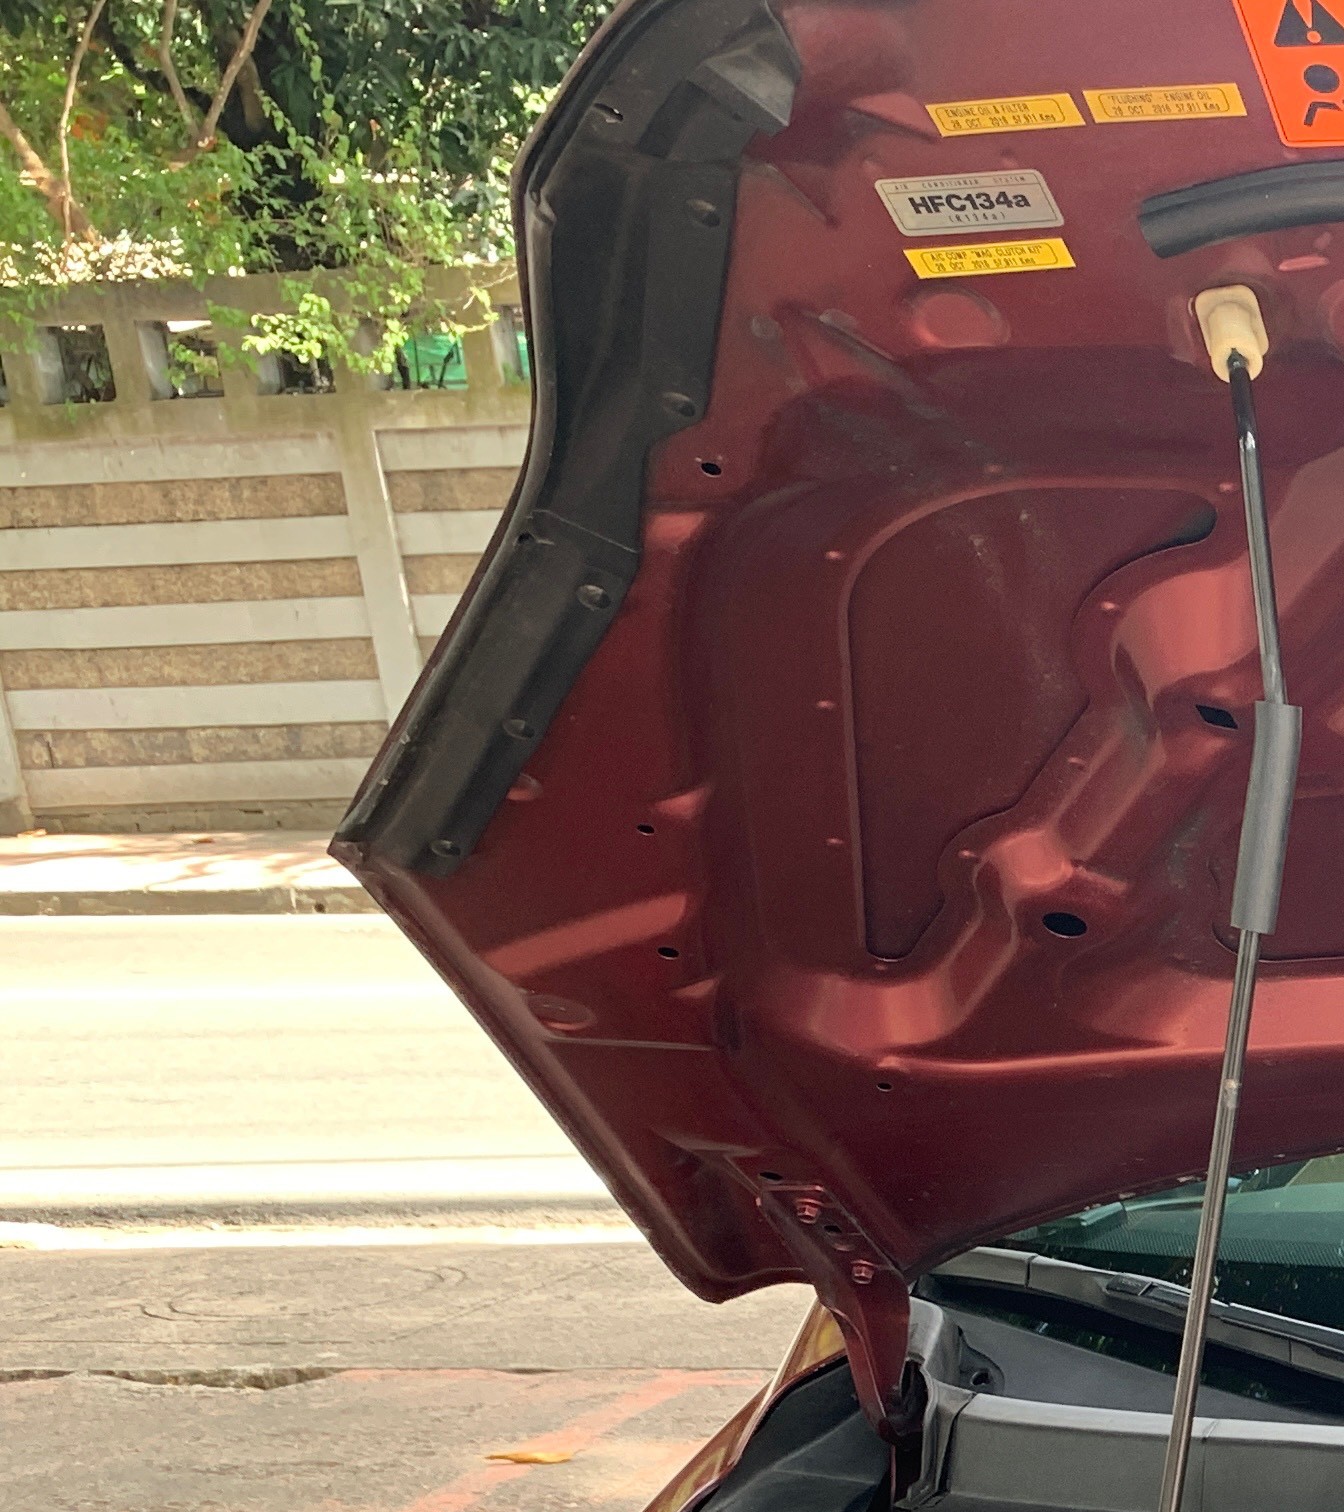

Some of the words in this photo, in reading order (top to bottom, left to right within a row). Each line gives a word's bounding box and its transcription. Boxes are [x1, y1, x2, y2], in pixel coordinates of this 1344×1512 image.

[1163, 91, 1195, 102] ENGINE
[1196, 90, 1212, 101] OIL
[945, 106, 976, 118] ENGINE
[1001, 102, 1030, 113] FILTER
[1127, 104, 1145, 115] OCT
[965, 117, 981, 128] OCT
[908, 191, 1031, 214] HFC134a
[949, 261, 965, 271] OCT
